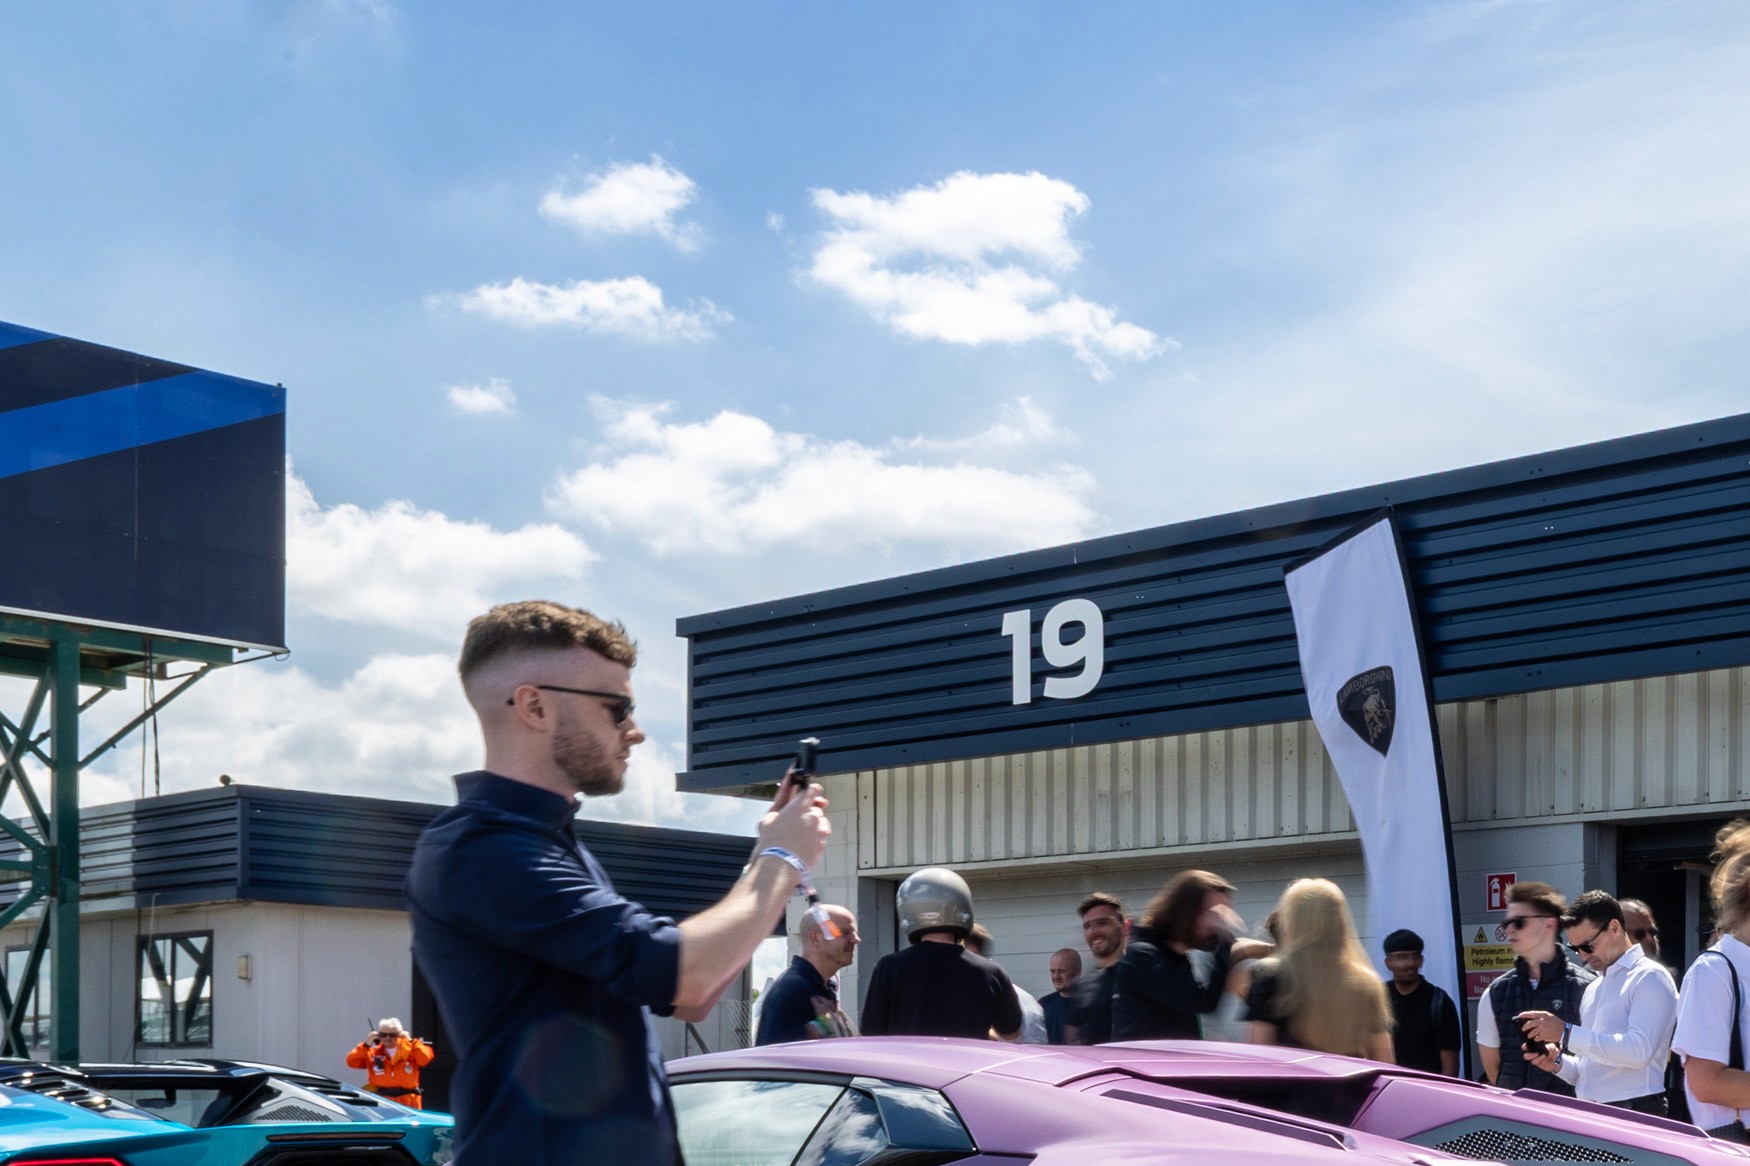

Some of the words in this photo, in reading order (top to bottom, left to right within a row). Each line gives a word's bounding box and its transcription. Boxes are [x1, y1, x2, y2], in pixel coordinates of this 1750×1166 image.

[1001, 599, 1104, 705] 19
[1339, 669, 1392, 703] LAMBORGHINI
[1471, 948, 1506, 956] Petroleum
[1472, 958, 1494, 967] Highly
[1480, 975, 1491, 983] No
